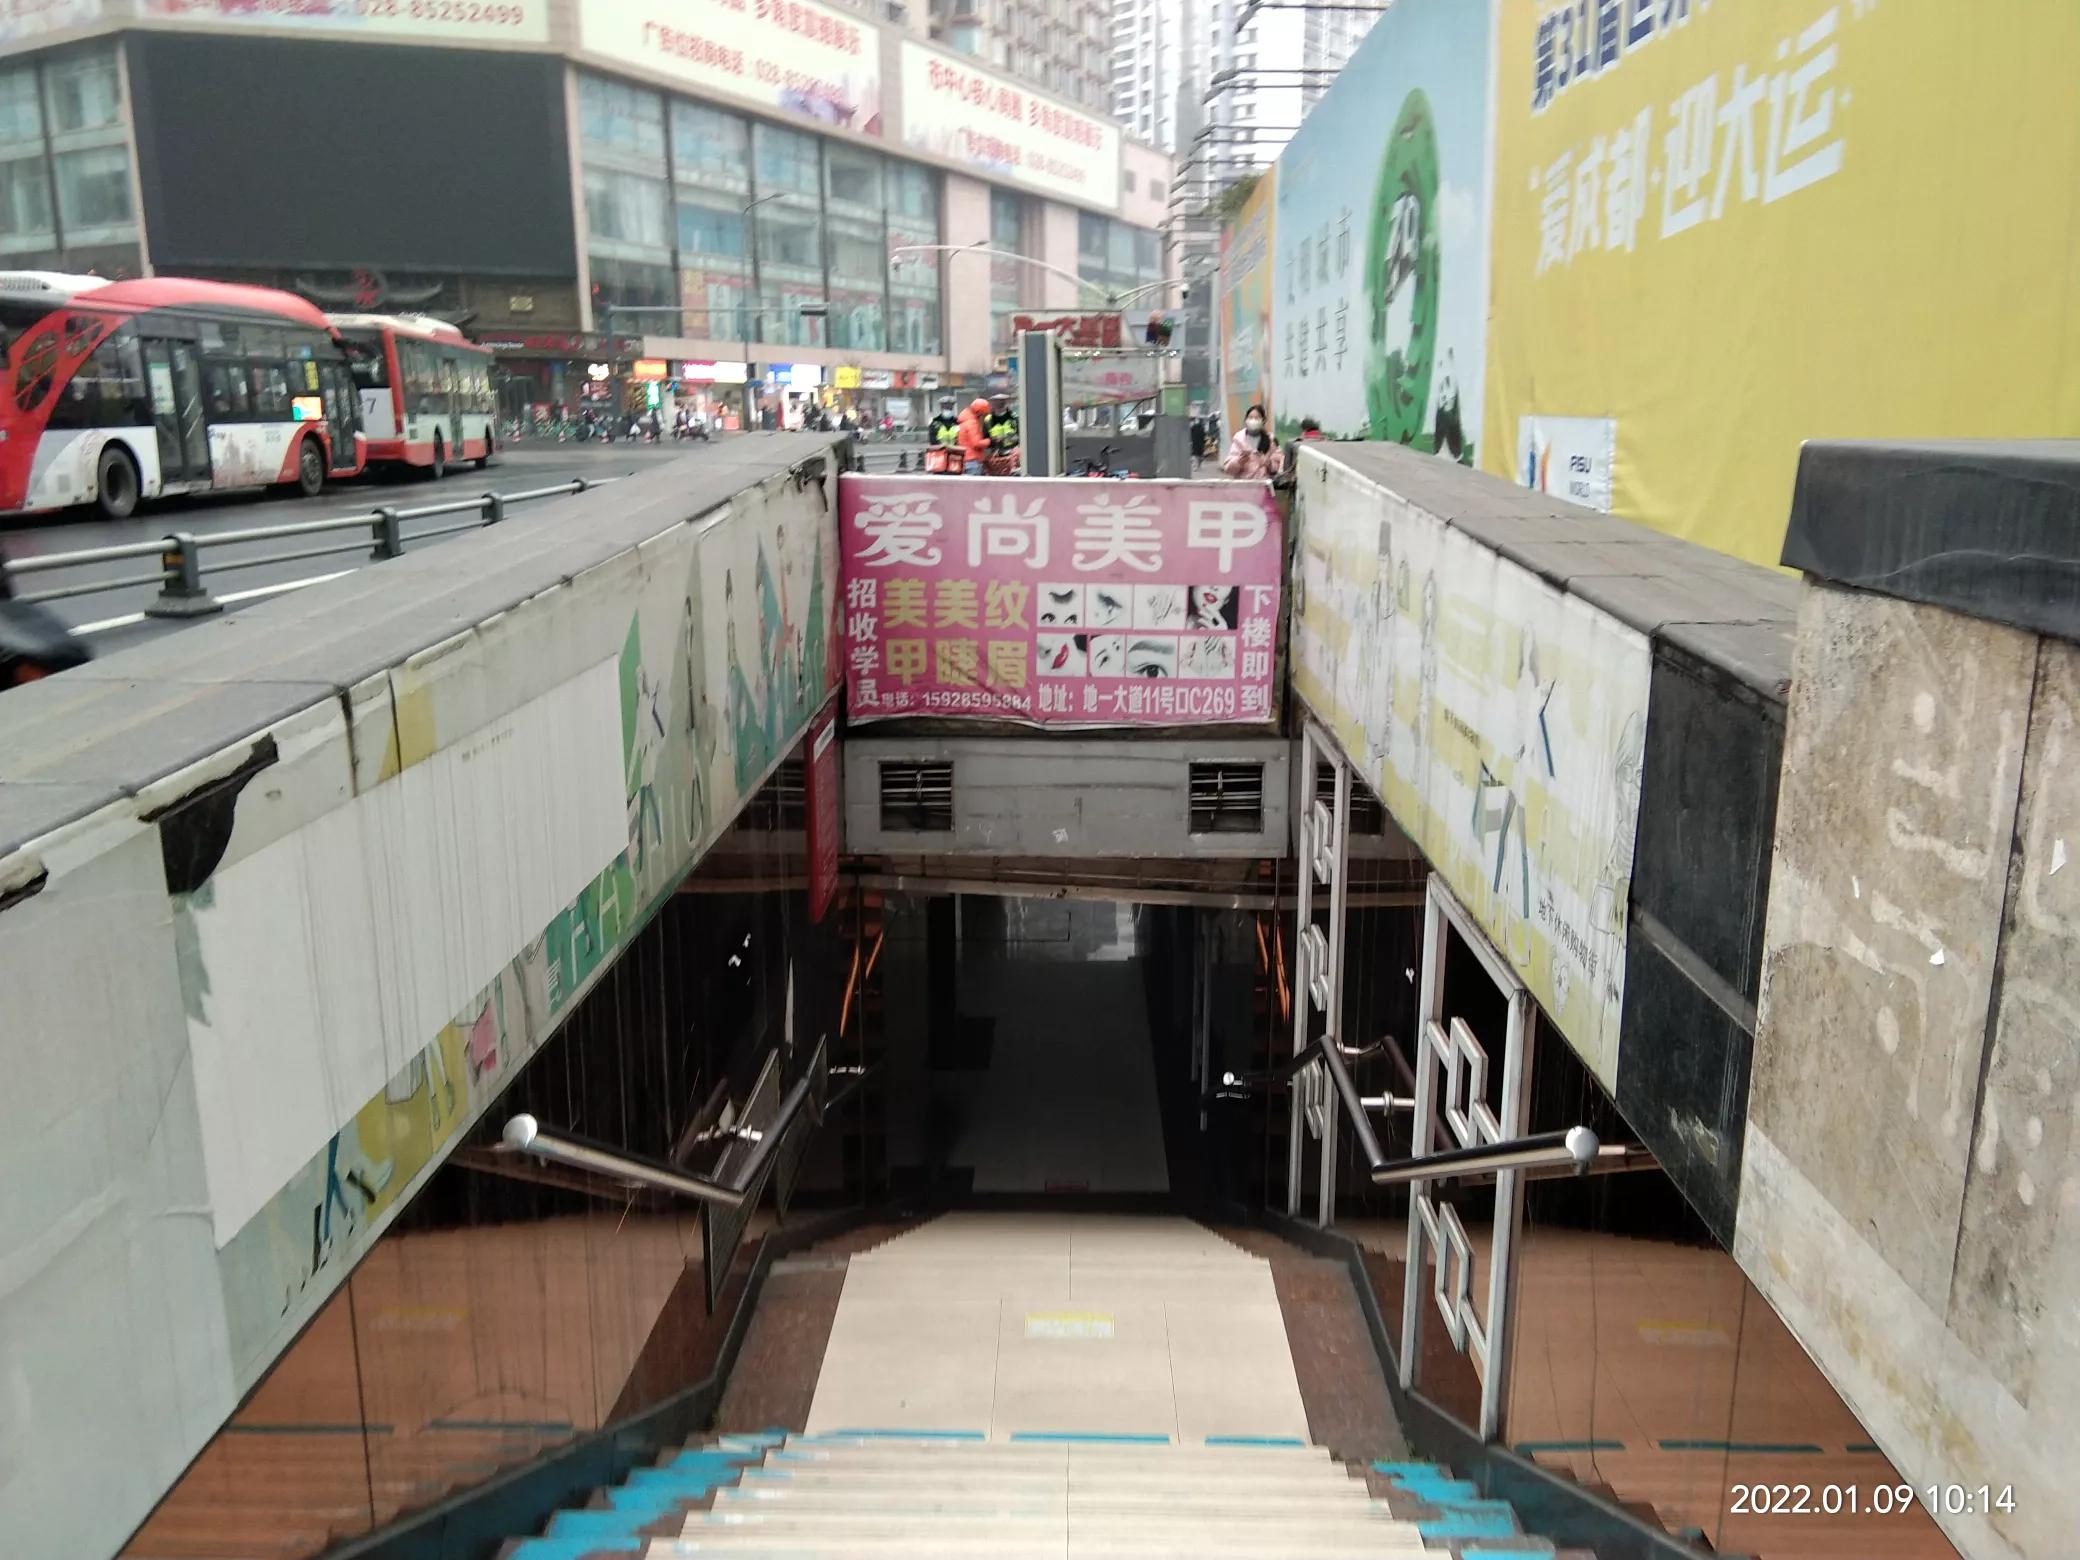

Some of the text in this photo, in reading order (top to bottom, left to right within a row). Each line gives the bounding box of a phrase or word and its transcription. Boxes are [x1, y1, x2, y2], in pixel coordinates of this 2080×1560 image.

[1284, 297, 1350, 379] 共建共享
[854, 492, 1267, 573] 爱尚美甲
[848, 578, 880, 710] 招收学员
[1241, 584, 1273, 714] 下楼即到
